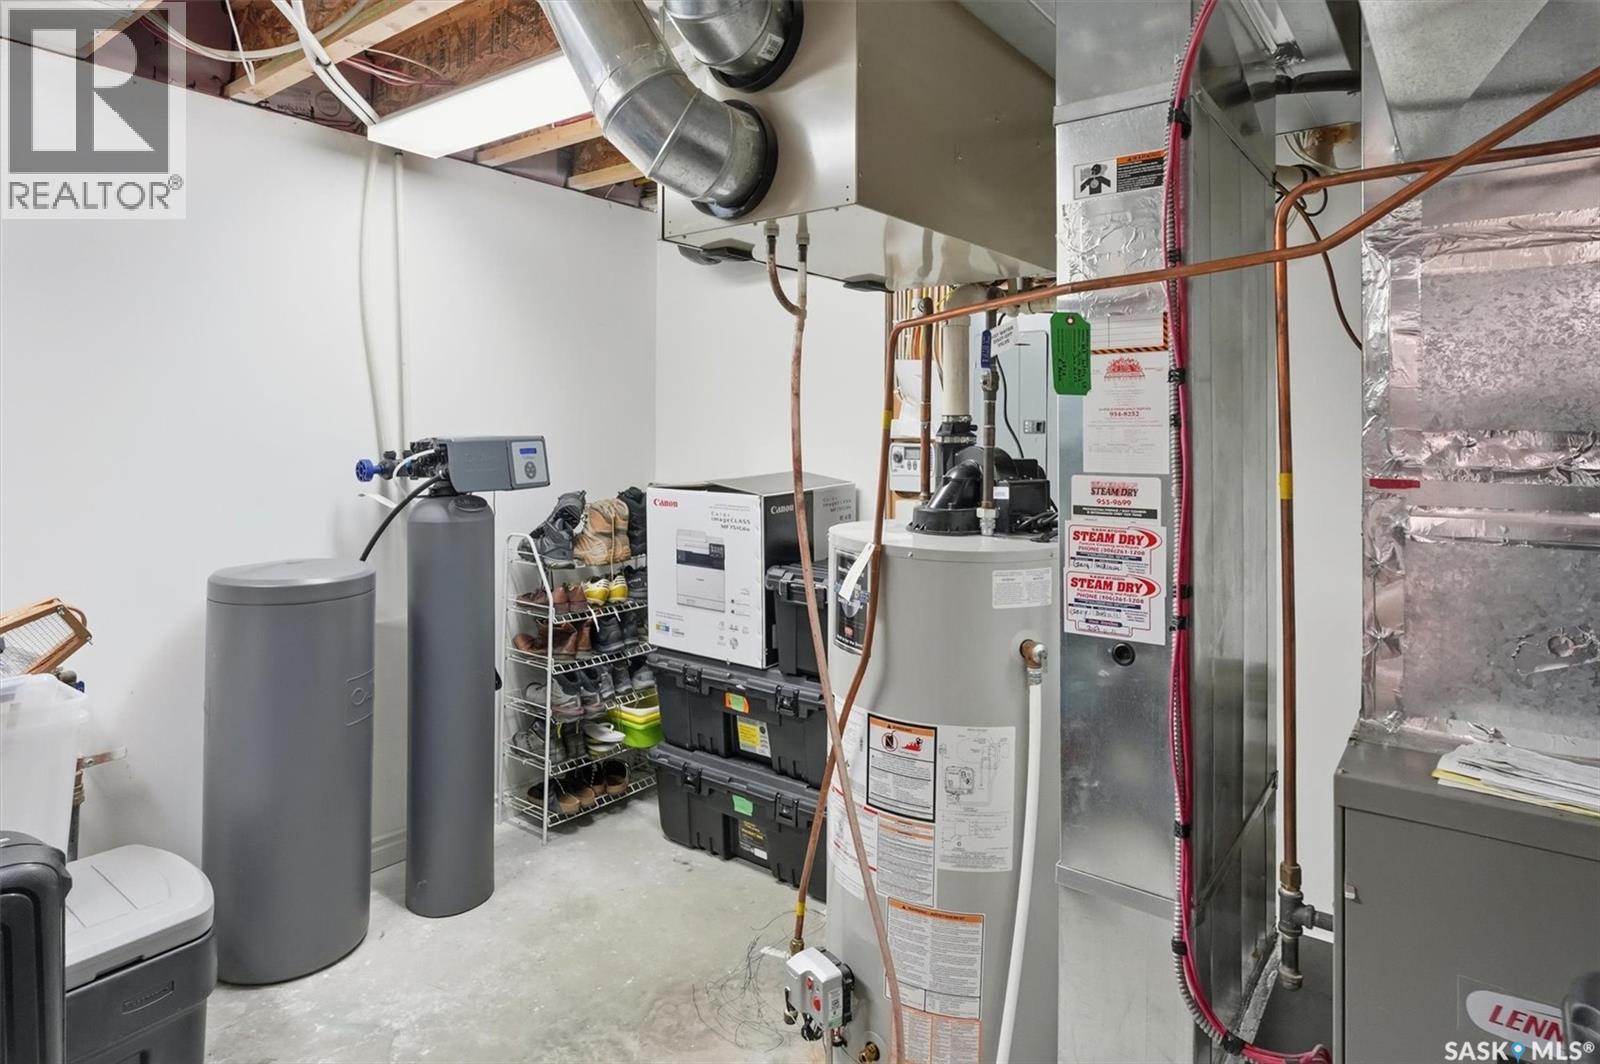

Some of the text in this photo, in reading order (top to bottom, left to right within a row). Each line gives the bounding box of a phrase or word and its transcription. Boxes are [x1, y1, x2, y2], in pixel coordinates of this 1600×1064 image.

[1090, 486, 1139, 497] STEAM DRY
[653, 498, 678, 508] Canon
[1072, 530, 1145, 546] STEAM DRY
[1070, 577, 1143, 594] STEAM DRY
